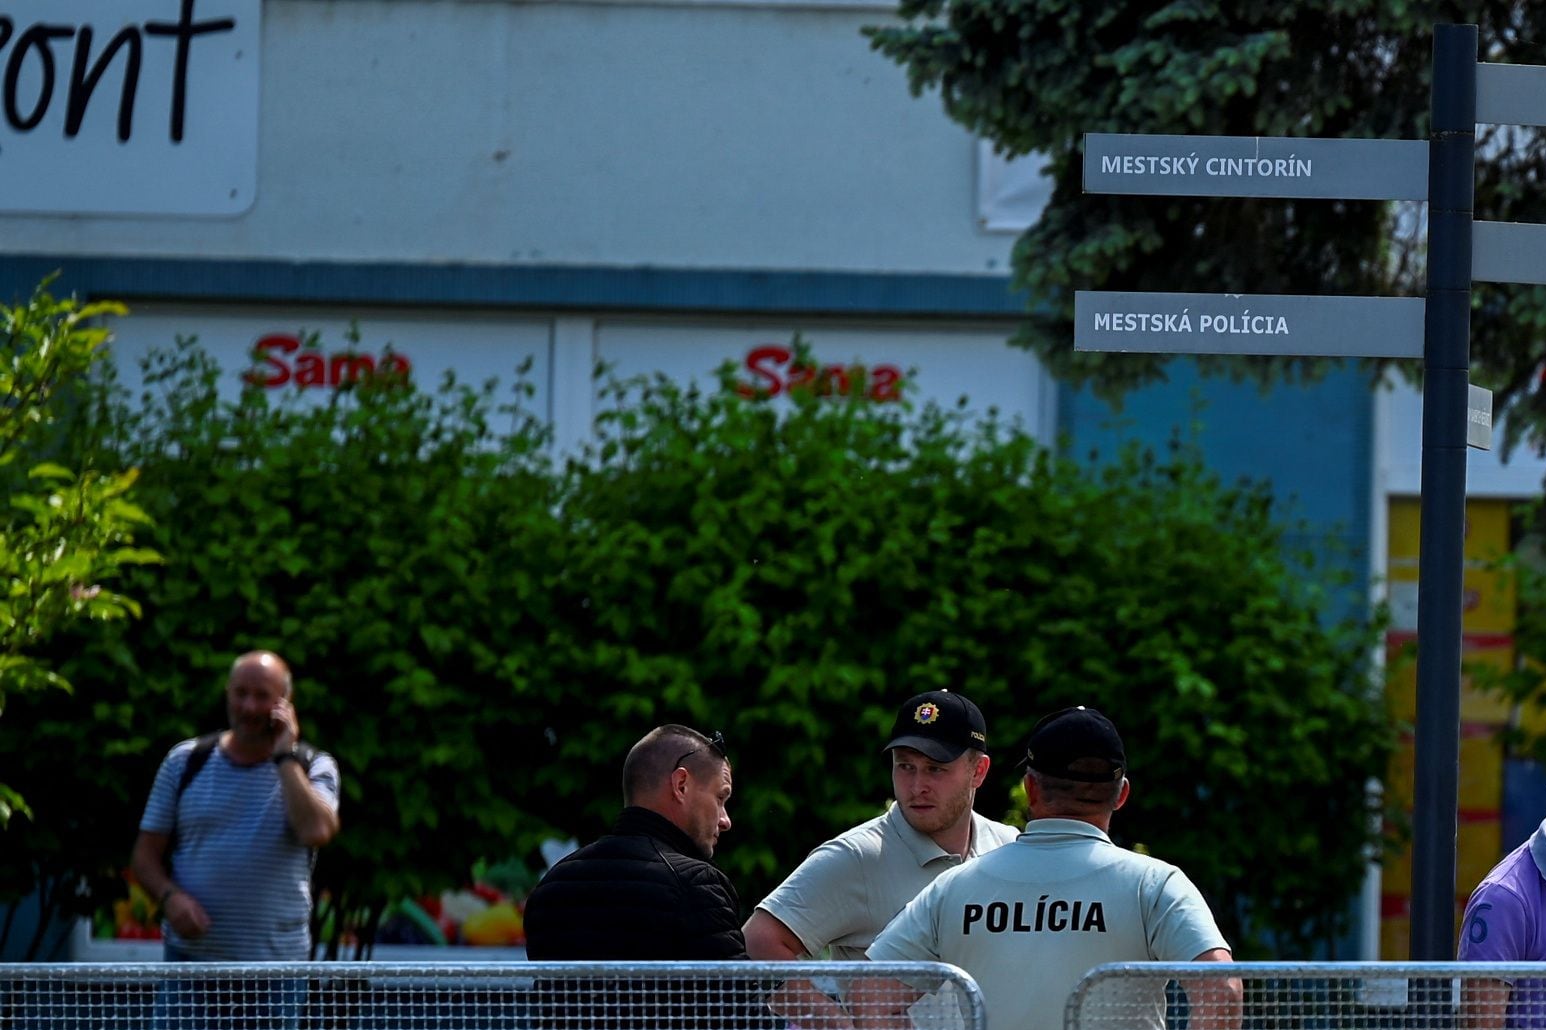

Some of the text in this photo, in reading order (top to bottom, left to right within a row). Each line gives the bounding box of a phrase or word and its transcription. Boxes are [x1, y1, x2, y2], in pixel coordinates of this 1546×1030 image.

[0, 0, 236, 155] ont
[1101, 152, 1313, 178] MESTSKÝ CINTORÍN
[1093, 308, 1290, 335] MESTSKÁ POLÍCIA
[962, 894, 1107, 936] POLÍCIA
